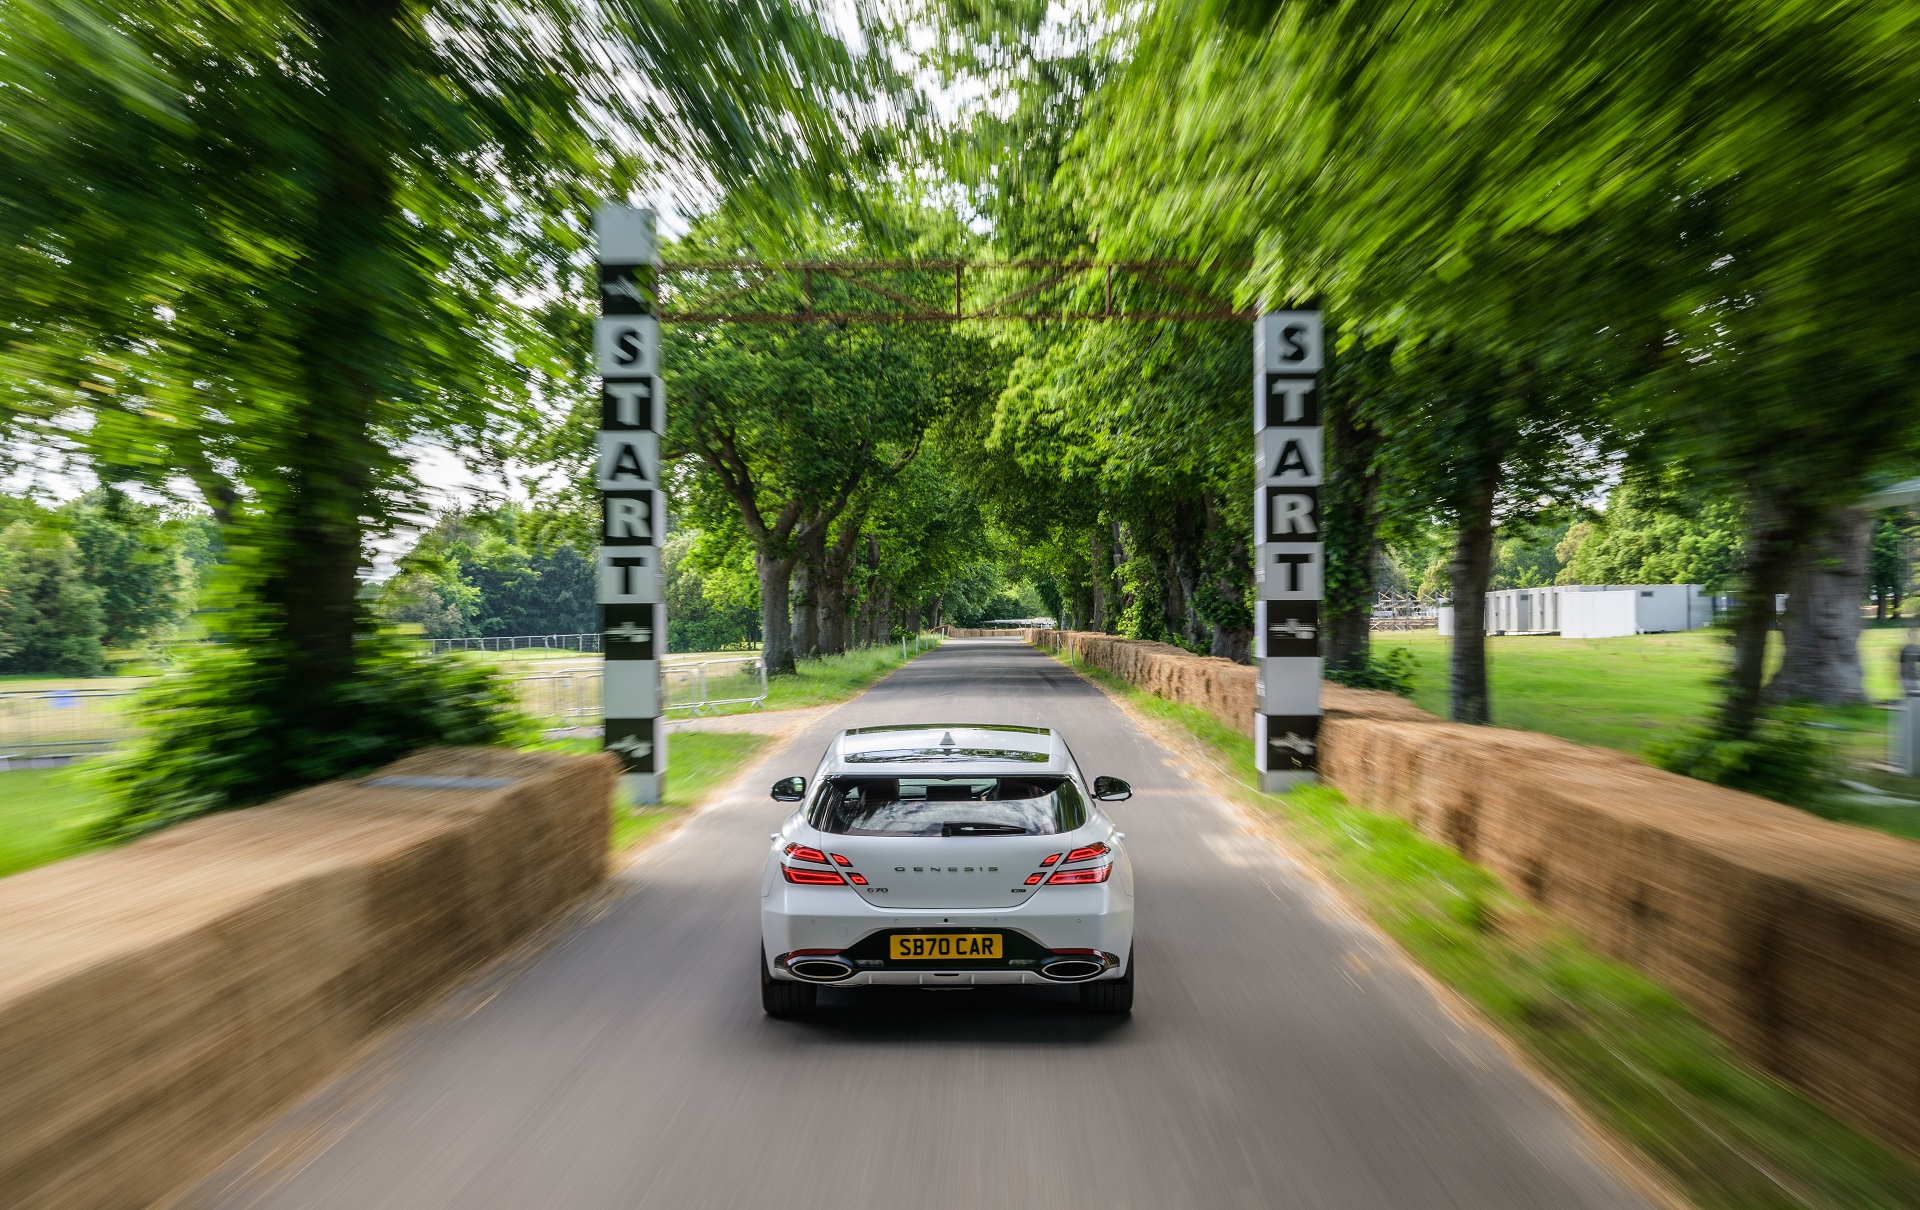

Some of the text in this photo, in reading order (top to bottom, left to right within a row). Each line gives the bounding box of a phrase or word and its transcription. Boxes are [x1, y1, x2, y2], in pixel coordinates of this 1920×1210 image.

[604, 329, 652, 595] START
[1271, 320, 1318, 592] START
[899, 937, 994, 956] SB70 CAR
